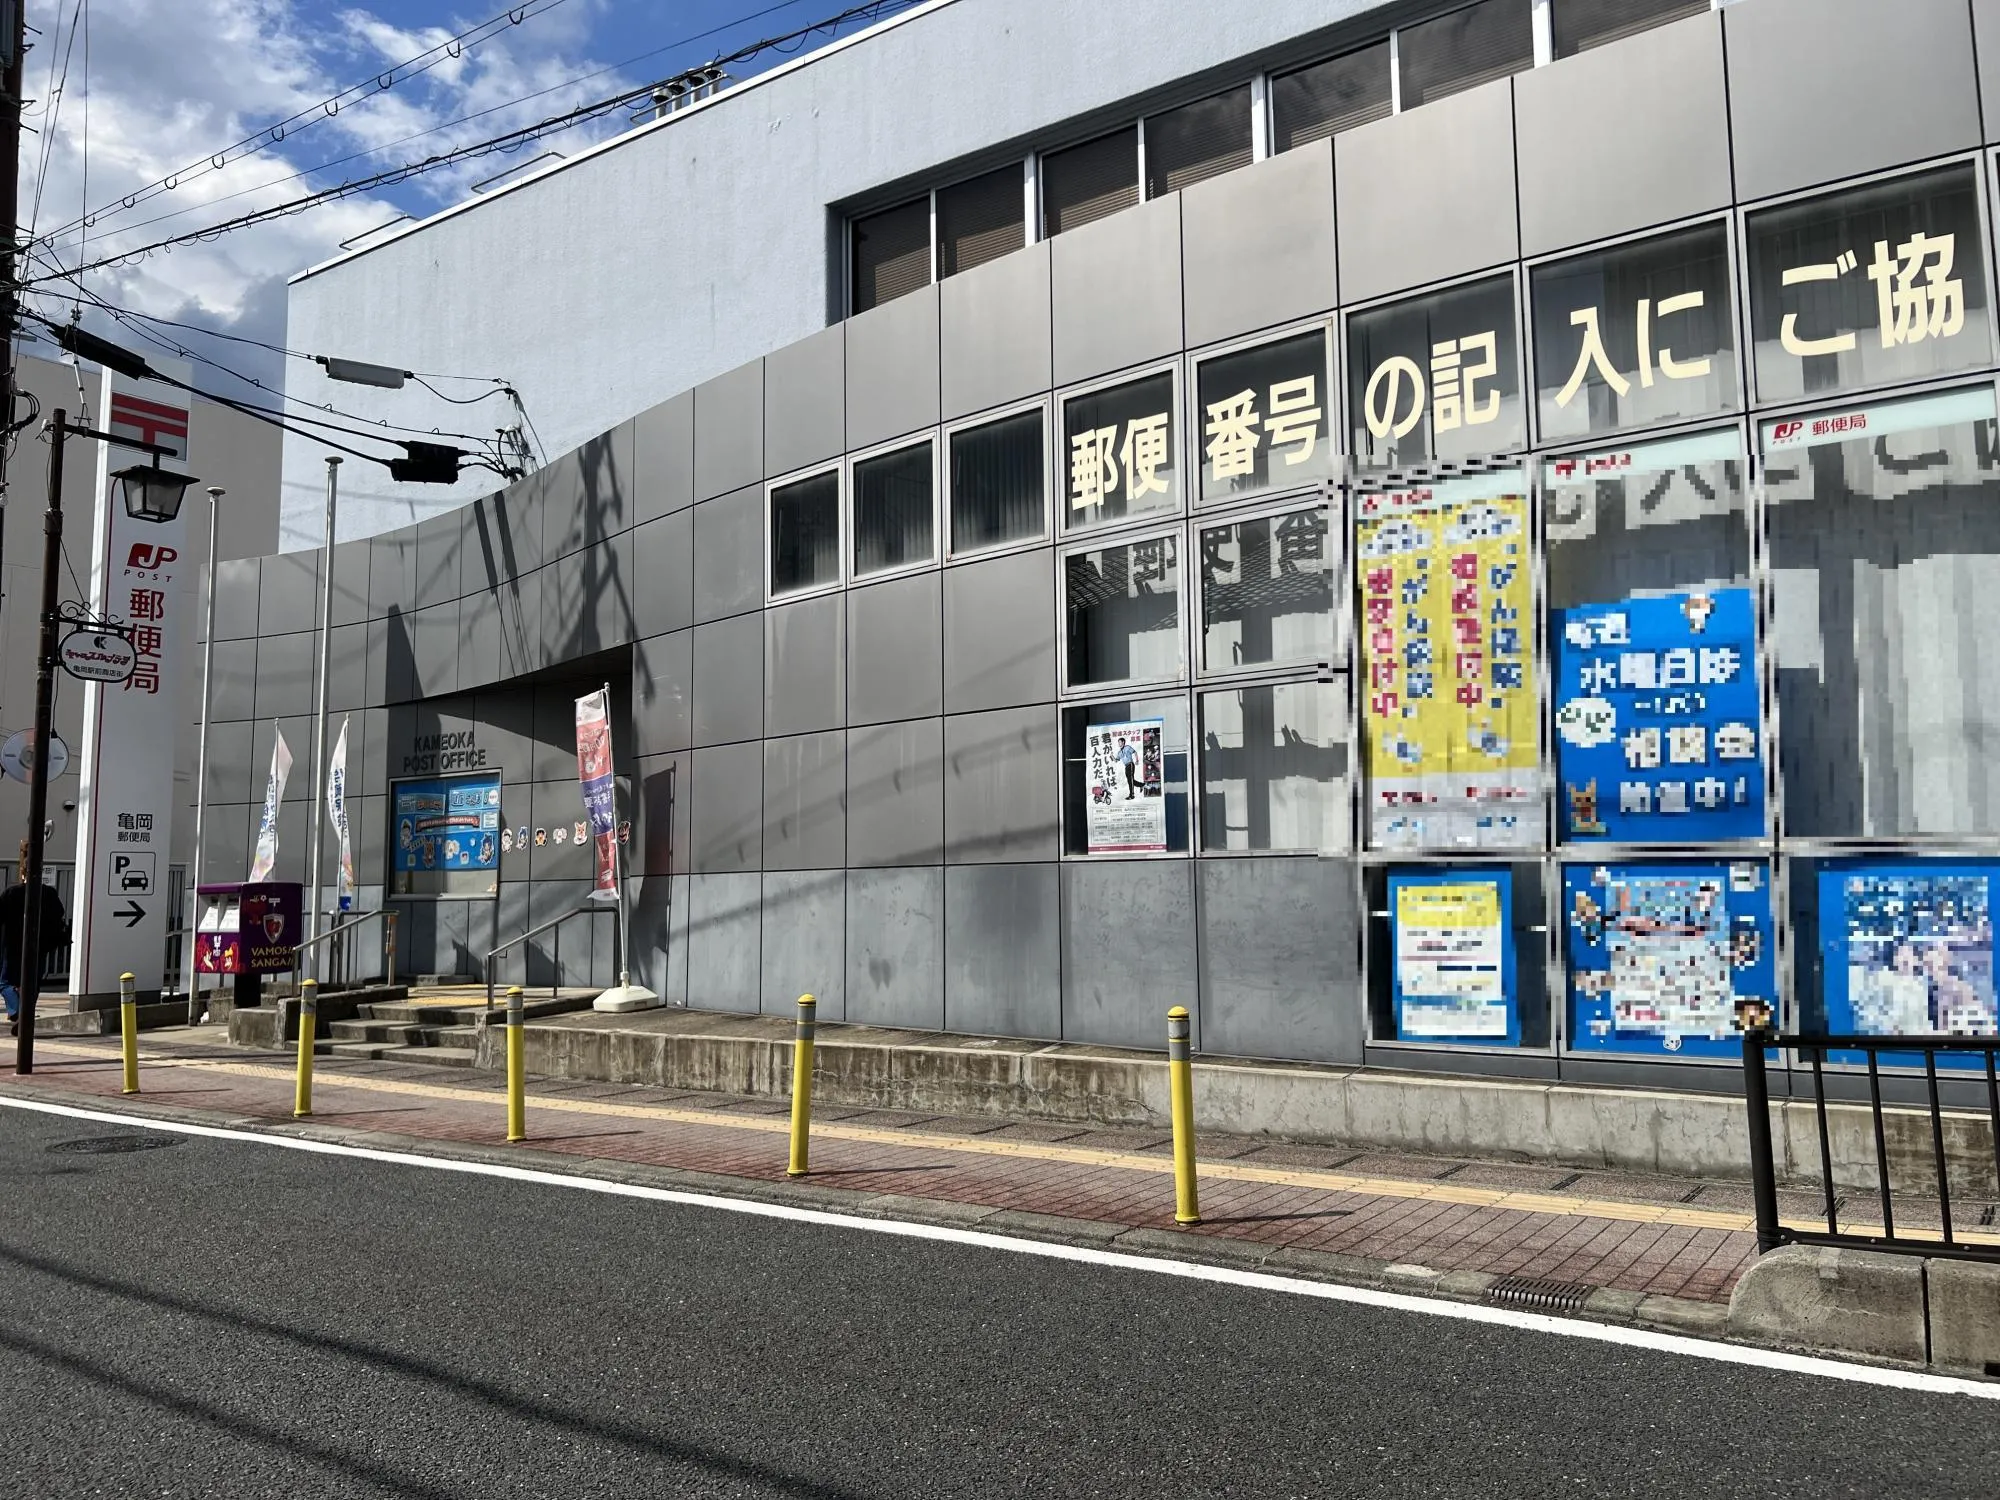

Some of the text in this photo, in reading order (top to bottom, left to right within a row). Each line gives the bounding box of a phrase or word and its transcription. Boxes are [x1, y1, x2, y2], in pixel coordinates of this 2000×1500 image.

[1812, 413, 1867, 436] 郵便局
[127, 543, 178, 570] JP
[124, 569, 172, 583] POST
[124, 588, 165, 695] 郵便局
[414, 731, 475, 752] KAMEOKA
[403, 749, 487, 772] POST OFFICE
[118, 813, 153, 830] 亀岡
[117, 831, 151, 843] 郵便局
[115, 856, 131, 874] P
